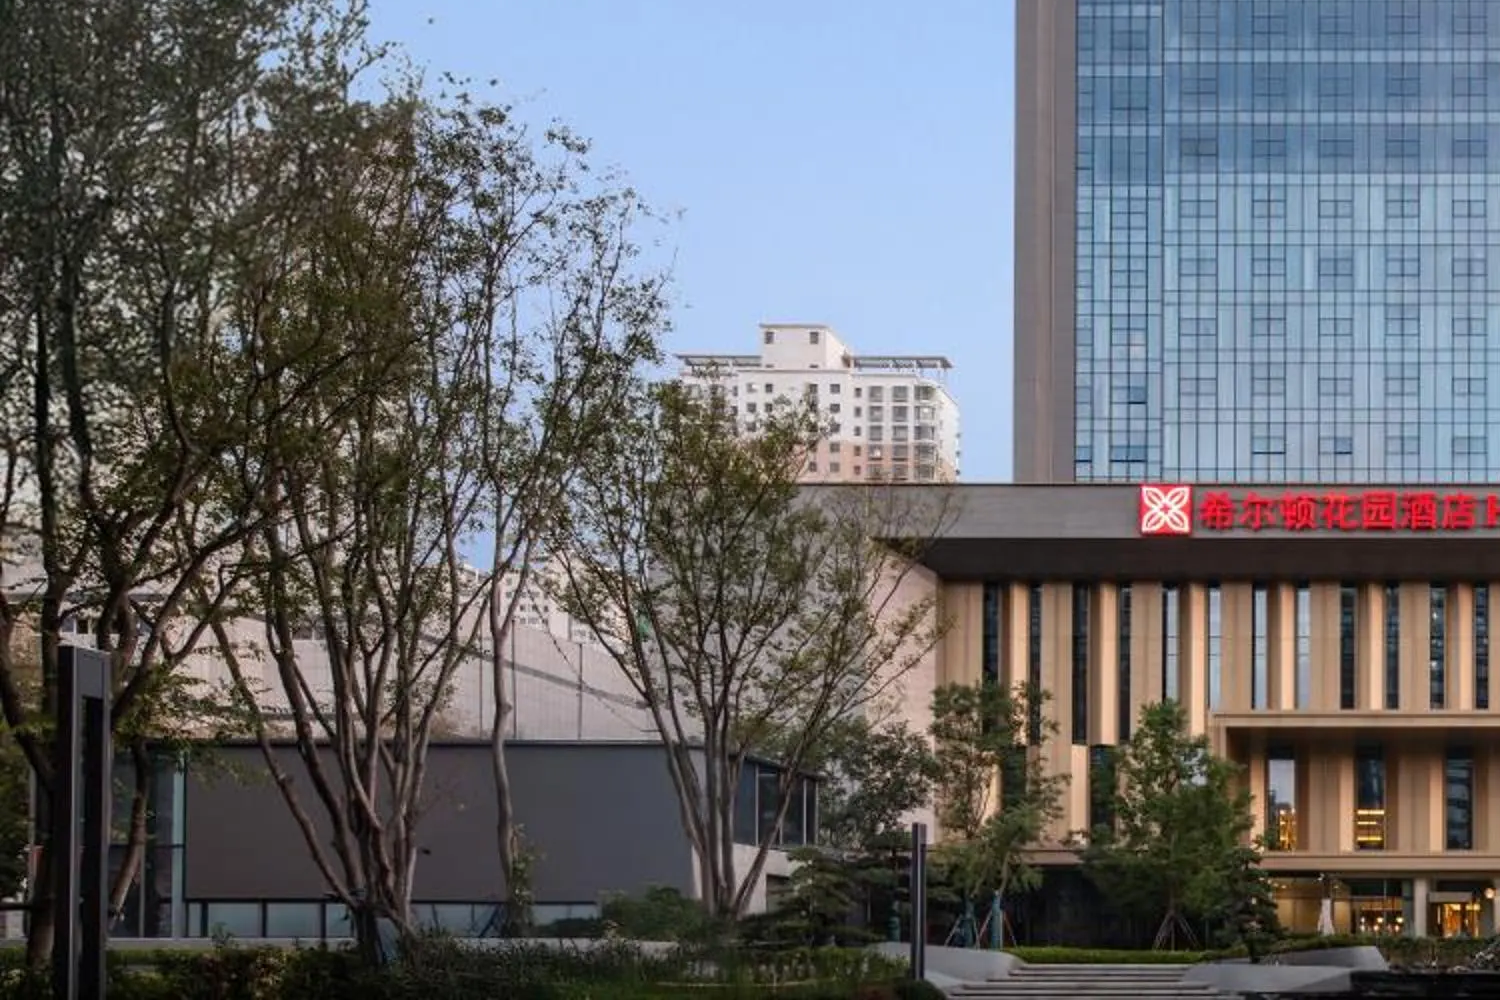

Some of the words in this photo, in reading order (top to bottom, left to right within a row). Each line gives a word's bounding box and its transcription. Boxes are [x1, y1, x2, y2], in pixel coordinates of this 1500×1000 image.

[1200, 493, 1477, 530] 希尔顿花园酒店
